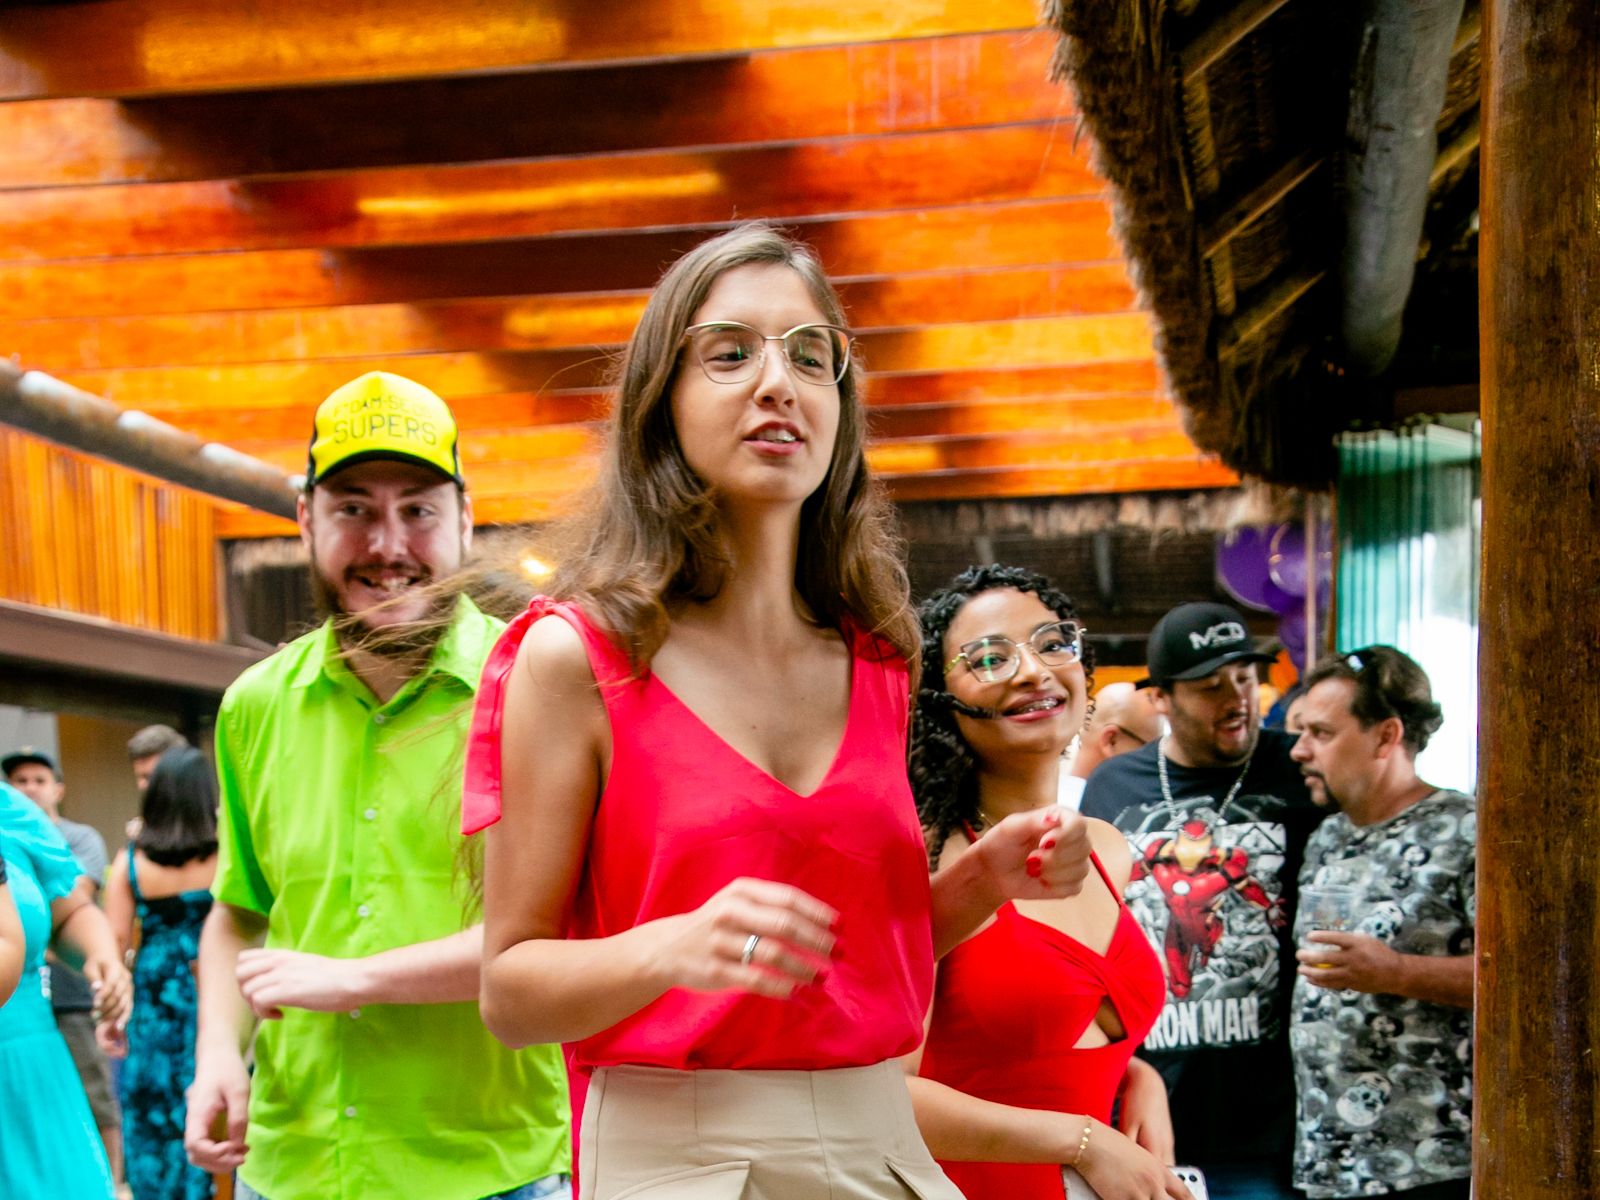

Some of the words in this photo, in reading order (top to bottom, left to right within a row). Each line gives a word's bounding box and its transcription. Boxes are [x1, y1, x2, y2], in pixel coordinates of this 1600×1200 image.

[333, 412, 437, 446] SUPERS
[1144, 1001, 1199, 1049] RON
[1202, 996, 1260, 1044] MAN
